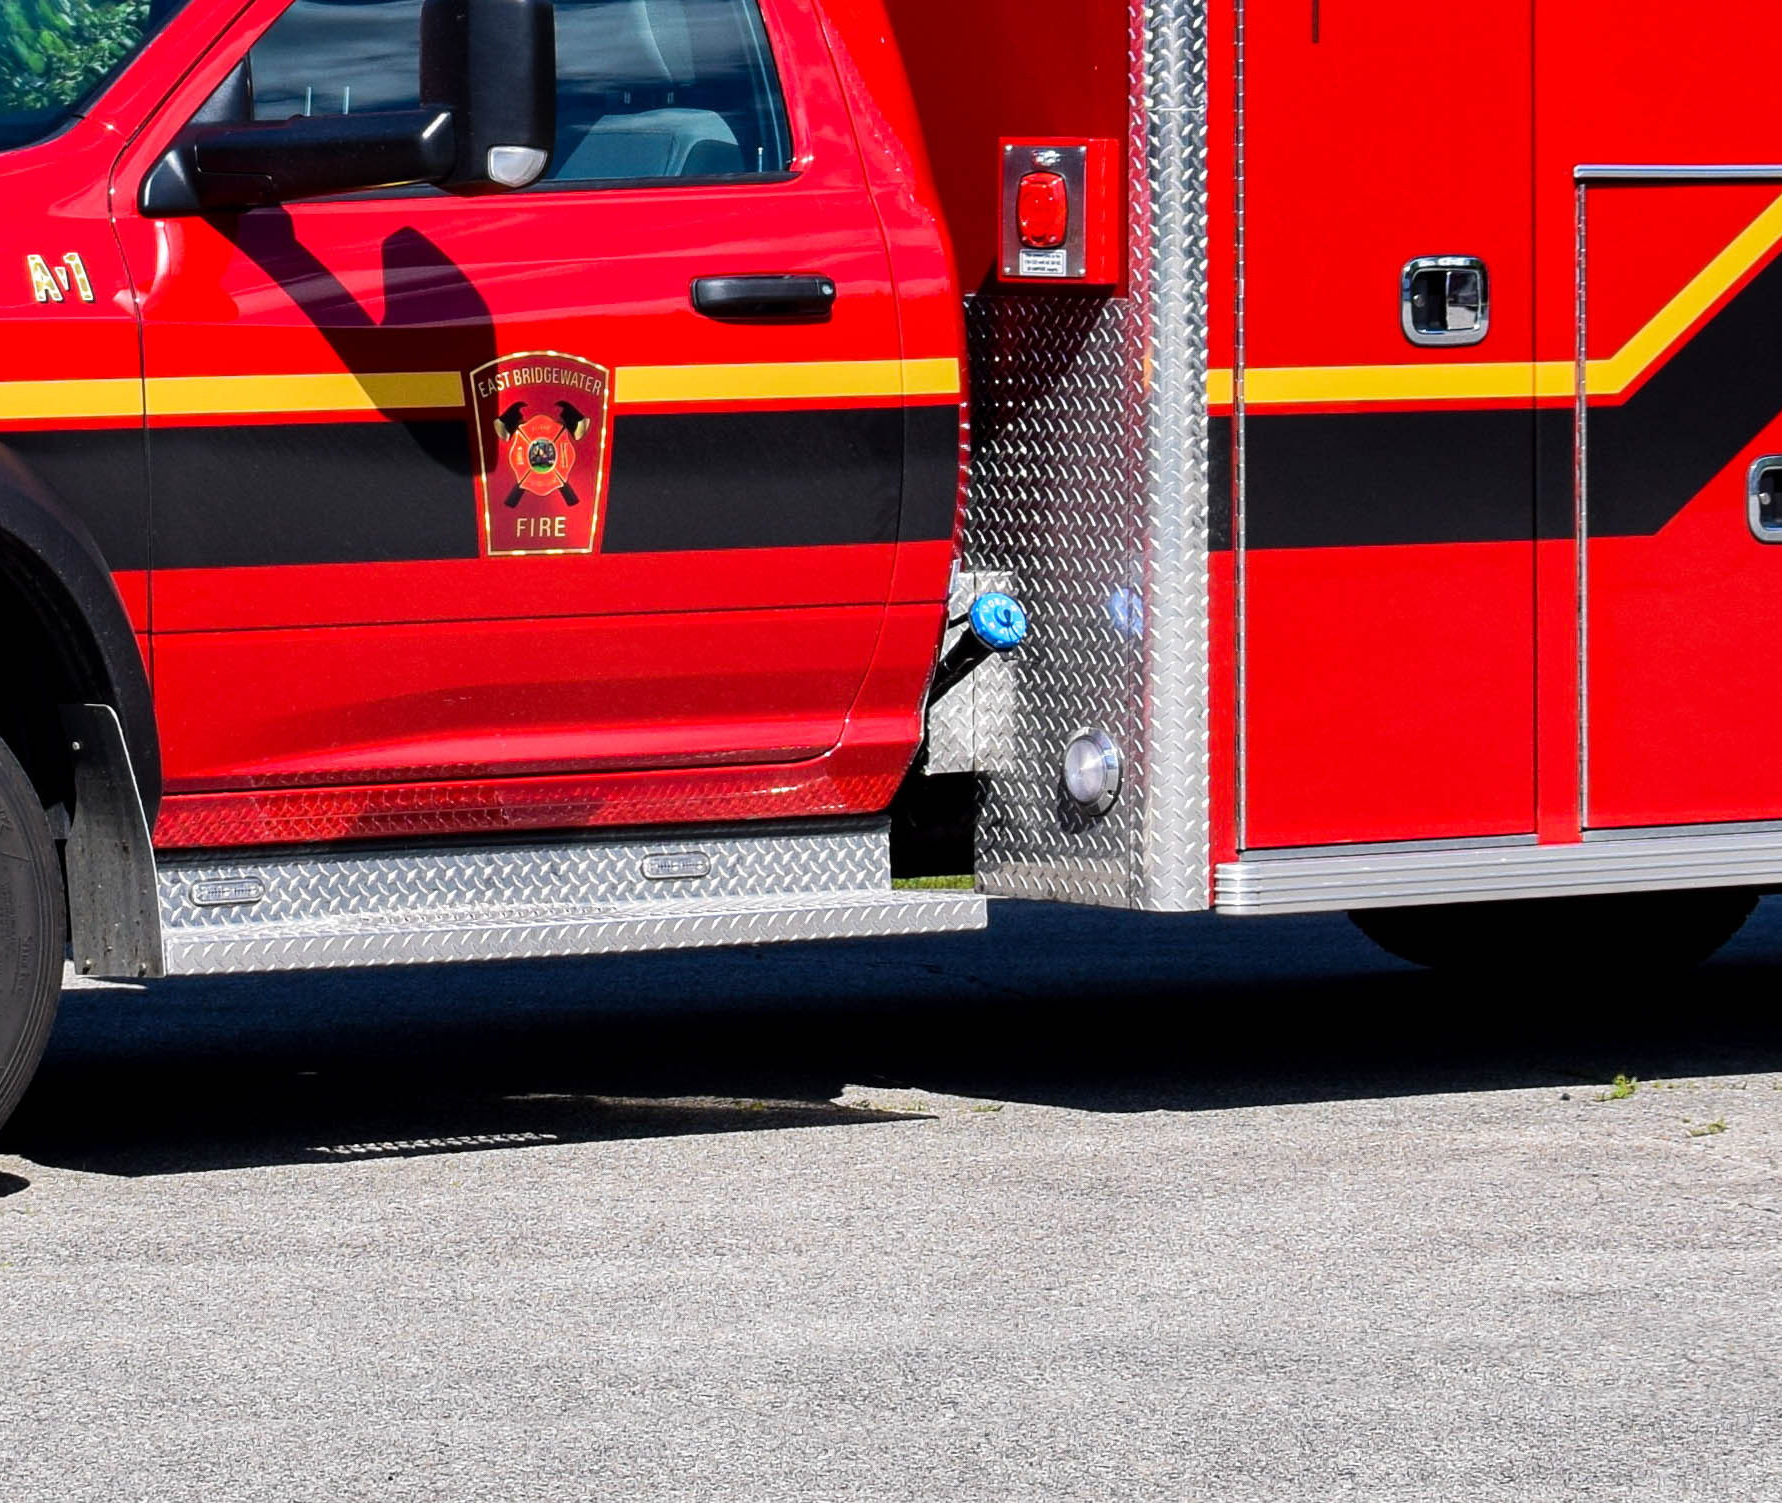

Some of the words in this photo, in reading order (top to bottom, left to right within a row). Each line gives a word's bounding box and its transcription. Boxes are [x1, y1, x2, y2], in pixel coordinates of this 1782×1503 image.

[478, 371, 510, 398] EAST
[513, 367, 603, 396] BRIDGEWATER
[516, 517, 567, 538] FIRE
